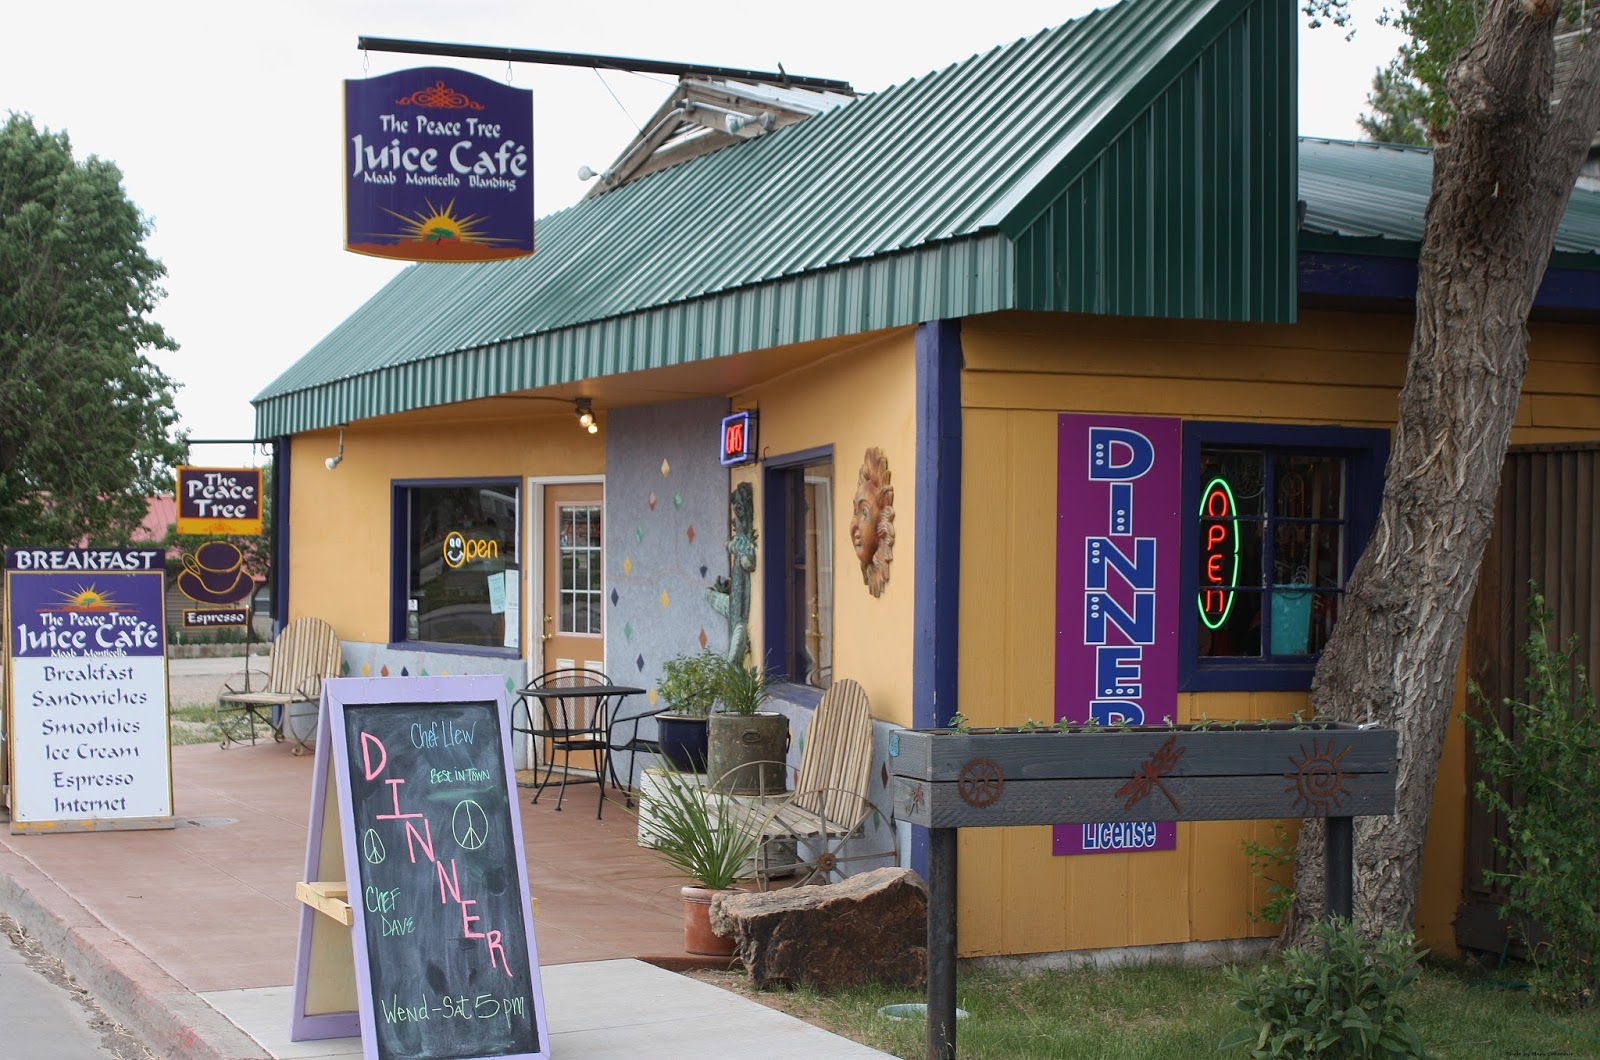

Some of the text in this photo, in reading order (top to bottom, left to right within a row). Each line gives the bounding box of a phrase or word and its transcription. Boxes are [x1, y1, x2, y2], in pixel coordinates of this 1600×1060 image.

[379, 114, 501, 138] The Peace Tree
[351, 133, 527, 178] Juice Café
[363, 171, 516, 192] Moab Monticello Blanding
[186, 479, 254, 499] Peace
[204, 472, 237, 488] The
[192, 499, 247, 518] Tree
[443, 531, 499, 568] Open
[15, 550, 157, 570] BREAKFAST
[39, 612, 138, 627] The Peace Tree
[187, 612, 245, 625] Espresso
[17, 621, 158, 655] Juice Café
[43, 663, 134, 682] Breakfast
[32, 687, 148, 707] Sandwiches
[41, 716, 141, 736] Smoothies
[45, 743, 139, 760] Ice Cream
[53, 771, 134, 791] Espresso
[54, 796, 126, 813] Internet
[1082, 821, 1157, 850] License
[360, 731, 513, 978] DINNER
